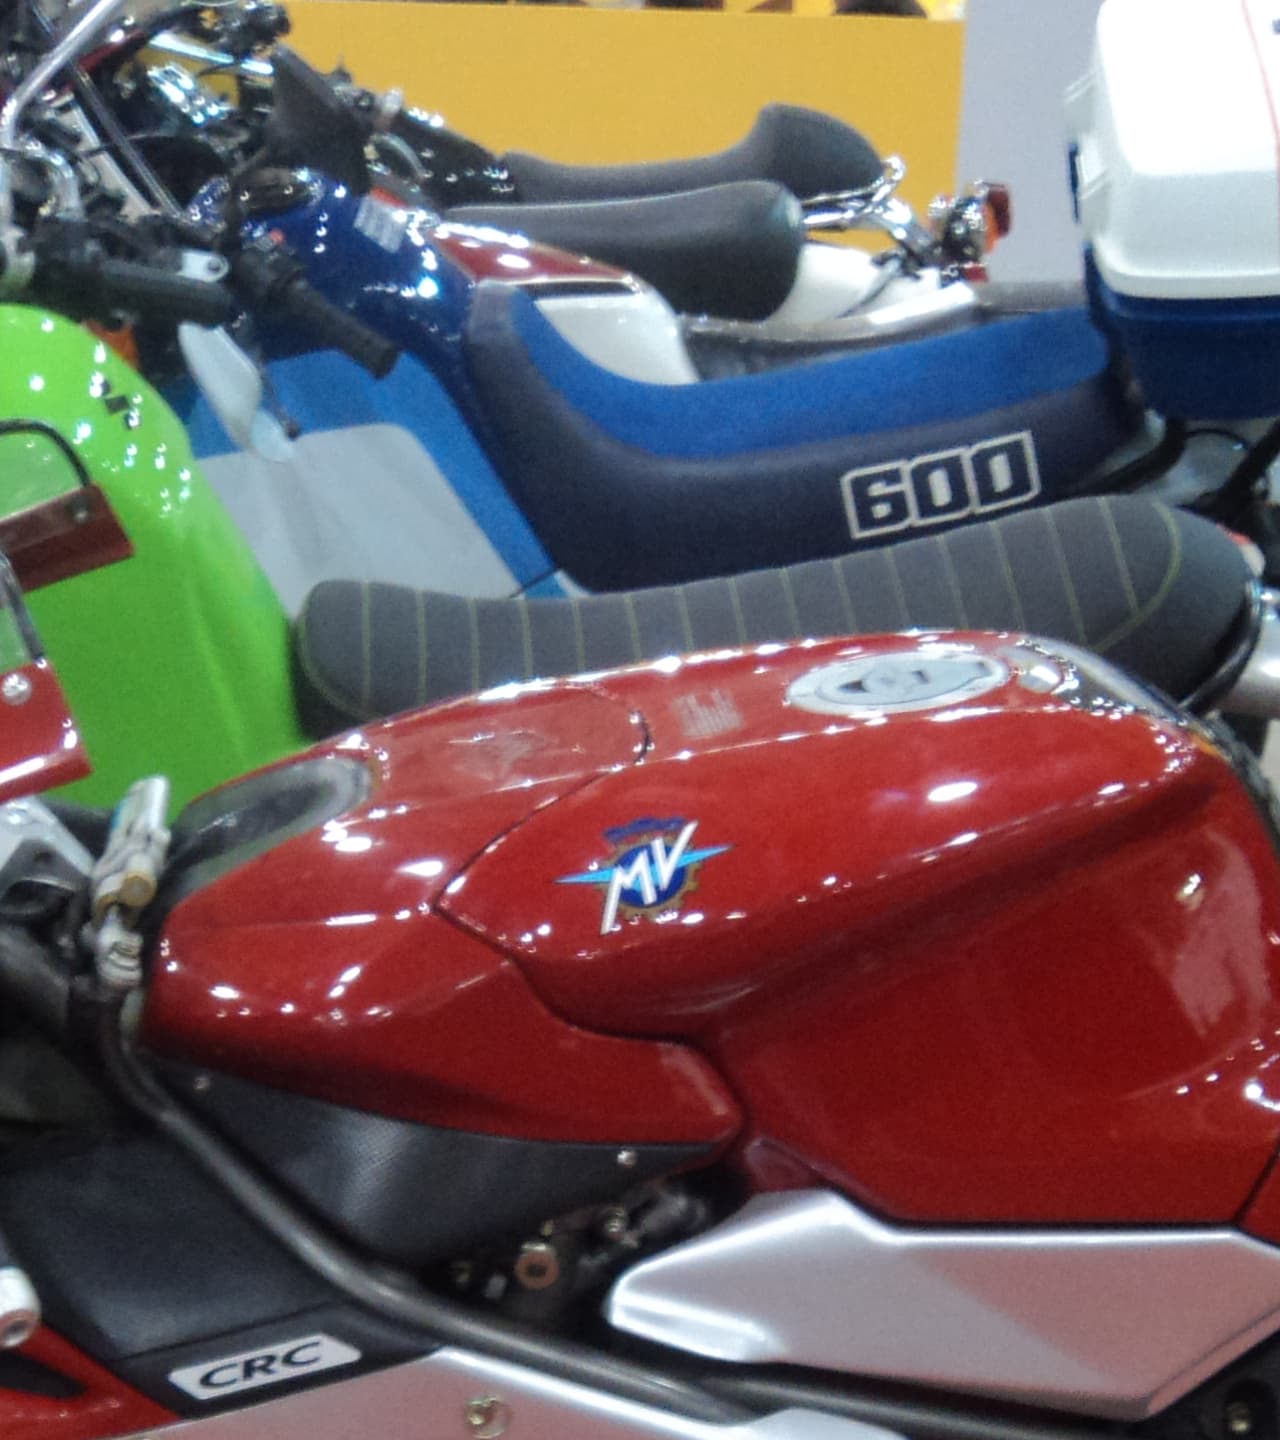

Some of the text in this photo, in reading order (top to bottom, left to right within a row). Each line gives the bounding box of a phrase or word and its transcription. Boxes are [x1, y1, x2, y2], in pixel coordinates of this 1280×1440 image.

[839, 430, 1043, 540] 600
[599, 818, 700, 937] MV
[198, 1340, 322, 1389] CRC
